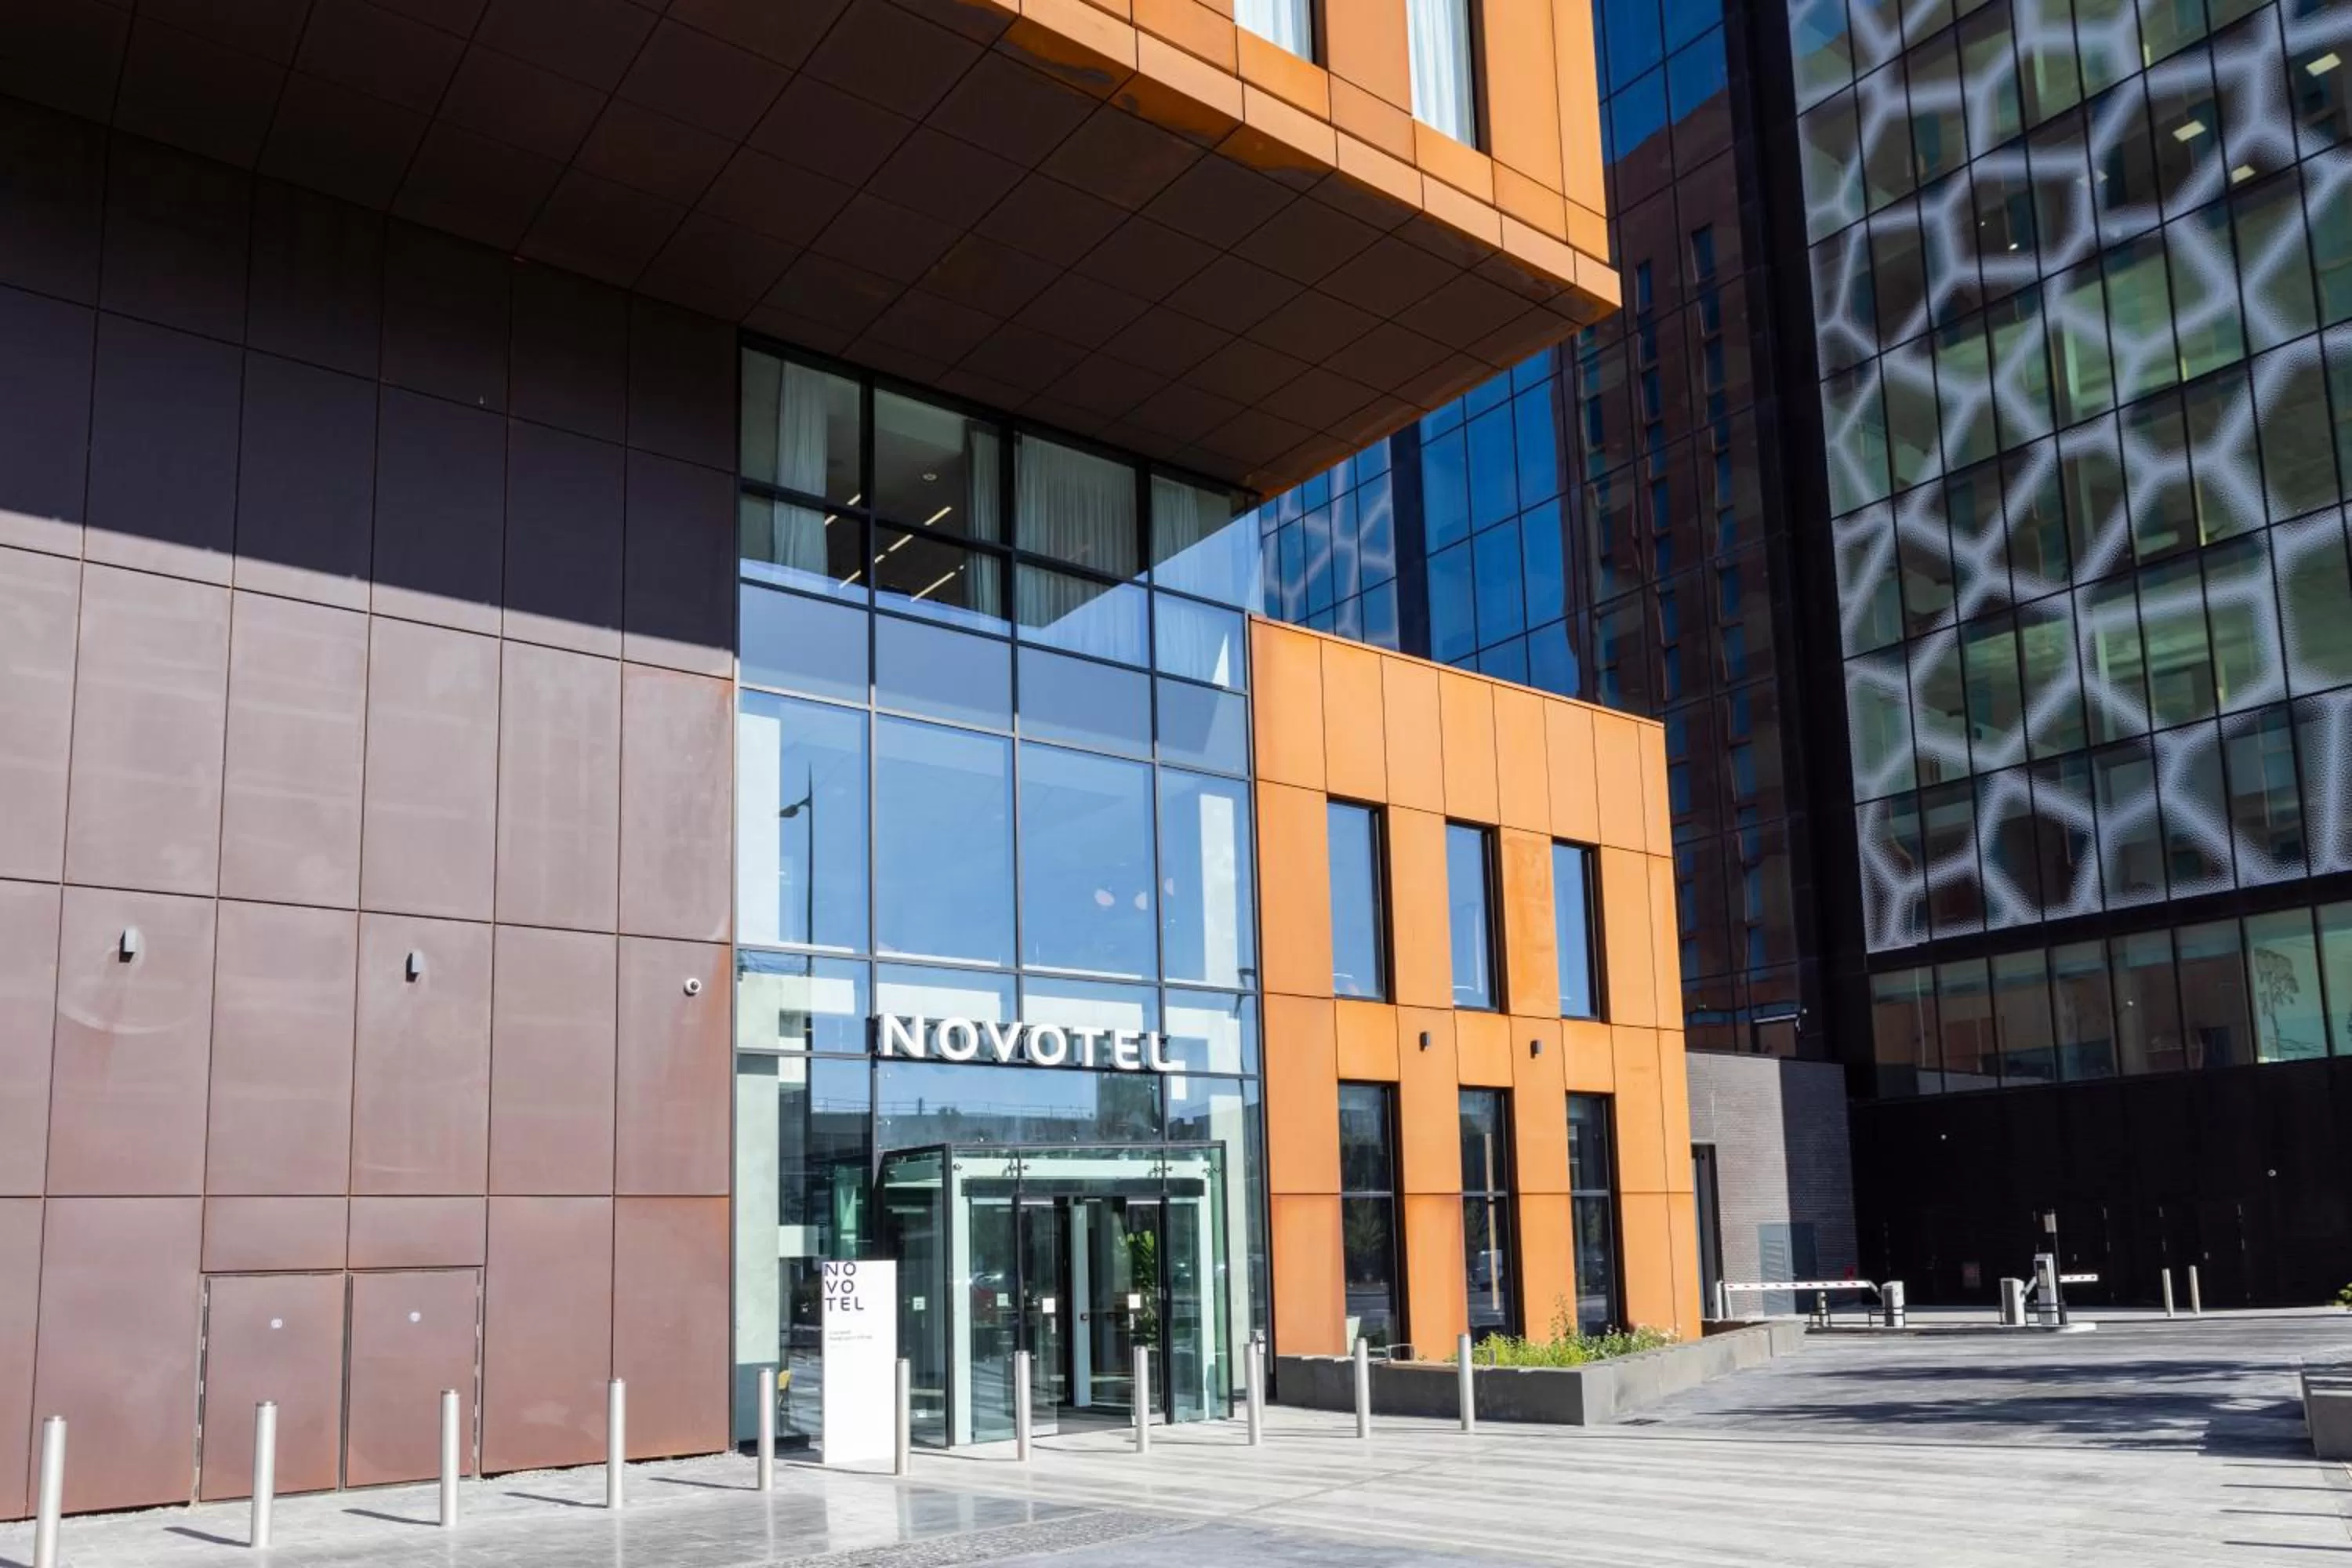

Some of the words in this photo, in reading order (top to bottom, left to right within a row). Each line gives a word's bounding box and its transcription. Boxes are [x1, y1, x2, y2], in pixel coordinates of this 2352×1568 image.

[879, 1013, 1185, 1071] NOVOTEL
[824, 1262, 857, 1277] NO
[826, 1279, 855, 1294] VO
[826, 1297, 865, 1312] TEL
